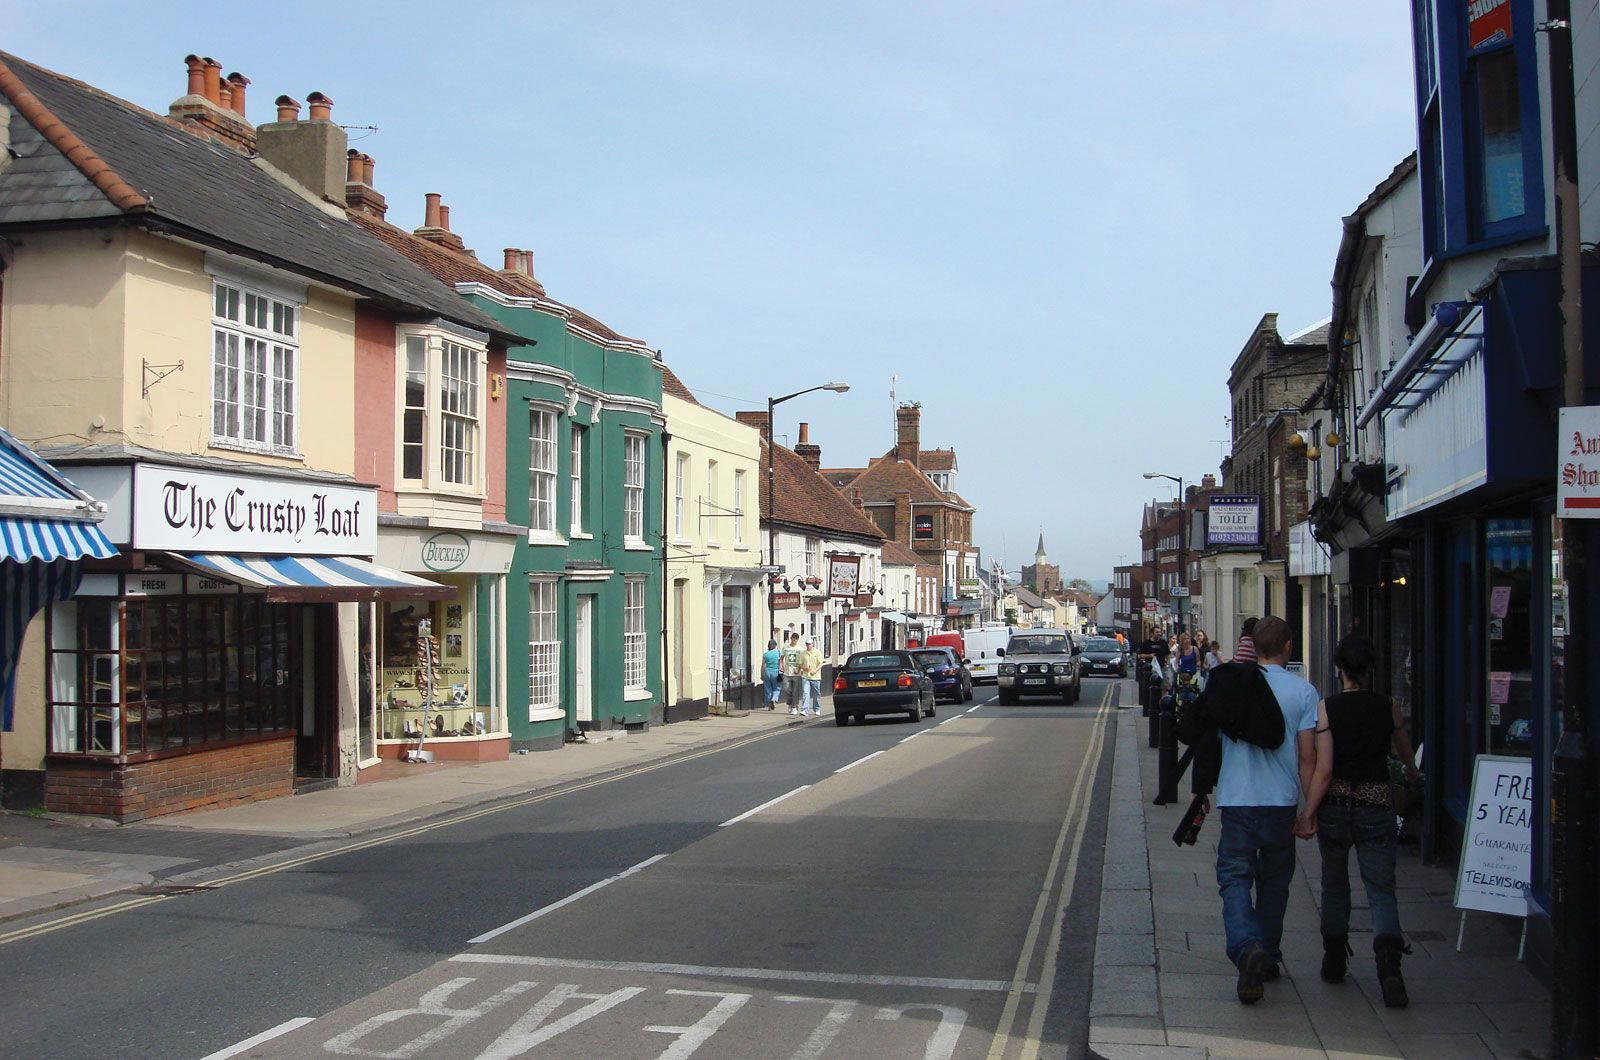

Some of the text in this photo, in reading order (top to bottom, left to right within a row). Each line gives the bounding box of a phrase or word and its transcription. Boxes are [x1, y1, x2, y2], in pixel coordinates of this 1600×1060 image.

[1569, 431, 1600, 457] An
[162, 480, 360, 544] The Crusty Loaf
[1218, 515, 1248, 524] TO LET
[425, 541, 466, 563] BUCKLES
[141, 580, 166, 590] FRESH
[1476, 803, 1488, 821] 5
